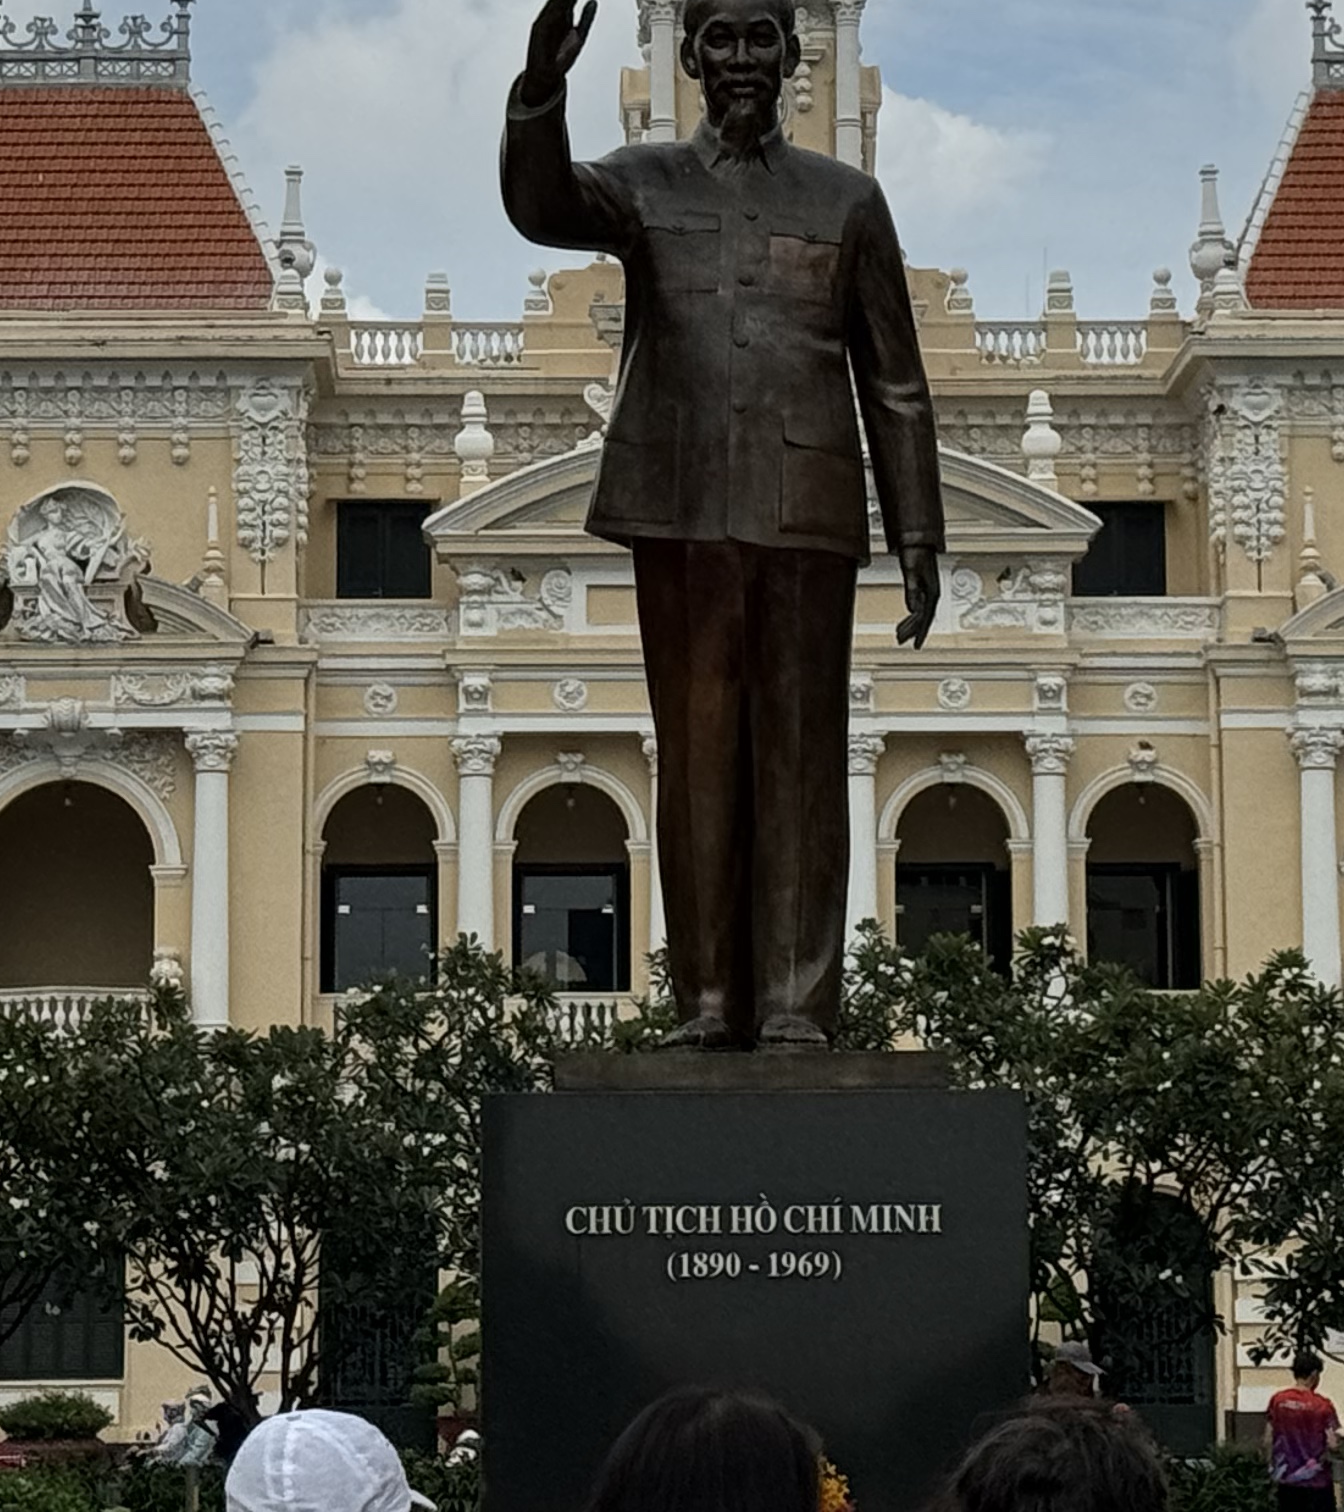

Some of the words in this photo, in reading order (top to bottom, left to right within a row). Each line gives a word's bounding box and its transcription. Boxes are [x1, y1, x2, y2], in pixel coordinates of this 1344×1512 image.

[565, 1197, 635, 1234] CHỦ
[641, 1205, 721, 1240] TỊCH
[730, 1192, 777, 1234] HỒ
[783, 1196, 843, 1233] CHÍ
[850, 1204, 942, 1234] MINH
[666, 1251, 741, 1281] (1890
[748, 1263, 760, 1271] -
[768, 1251, 843, 1281] 1969)
